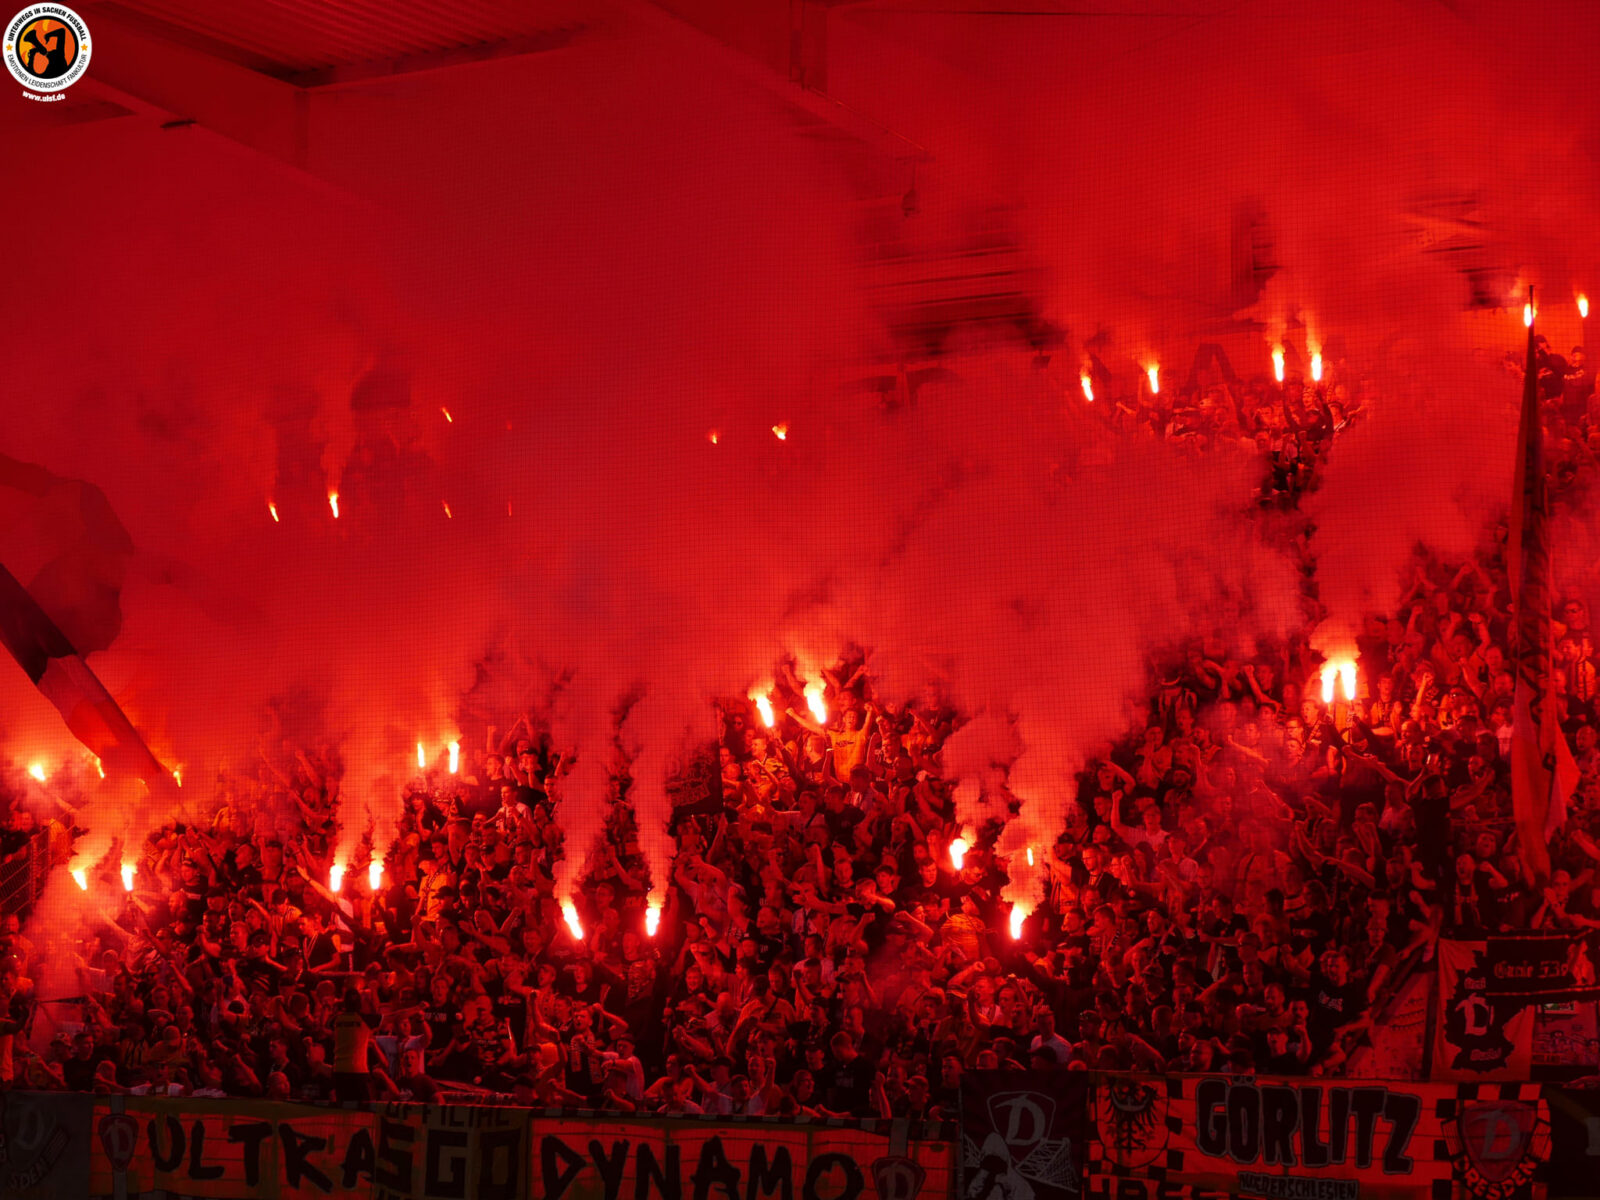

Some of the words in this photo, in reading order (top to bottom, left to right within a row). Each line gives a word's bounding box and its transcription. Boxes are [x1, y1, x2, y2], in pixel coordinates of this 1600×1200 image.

[1195, 1074, 1422, 1176] GÖRLITZ
[540, 1135, 866, 1200] DYNAMO
[1452, 1153, 1539, 1200] DRESDEN
